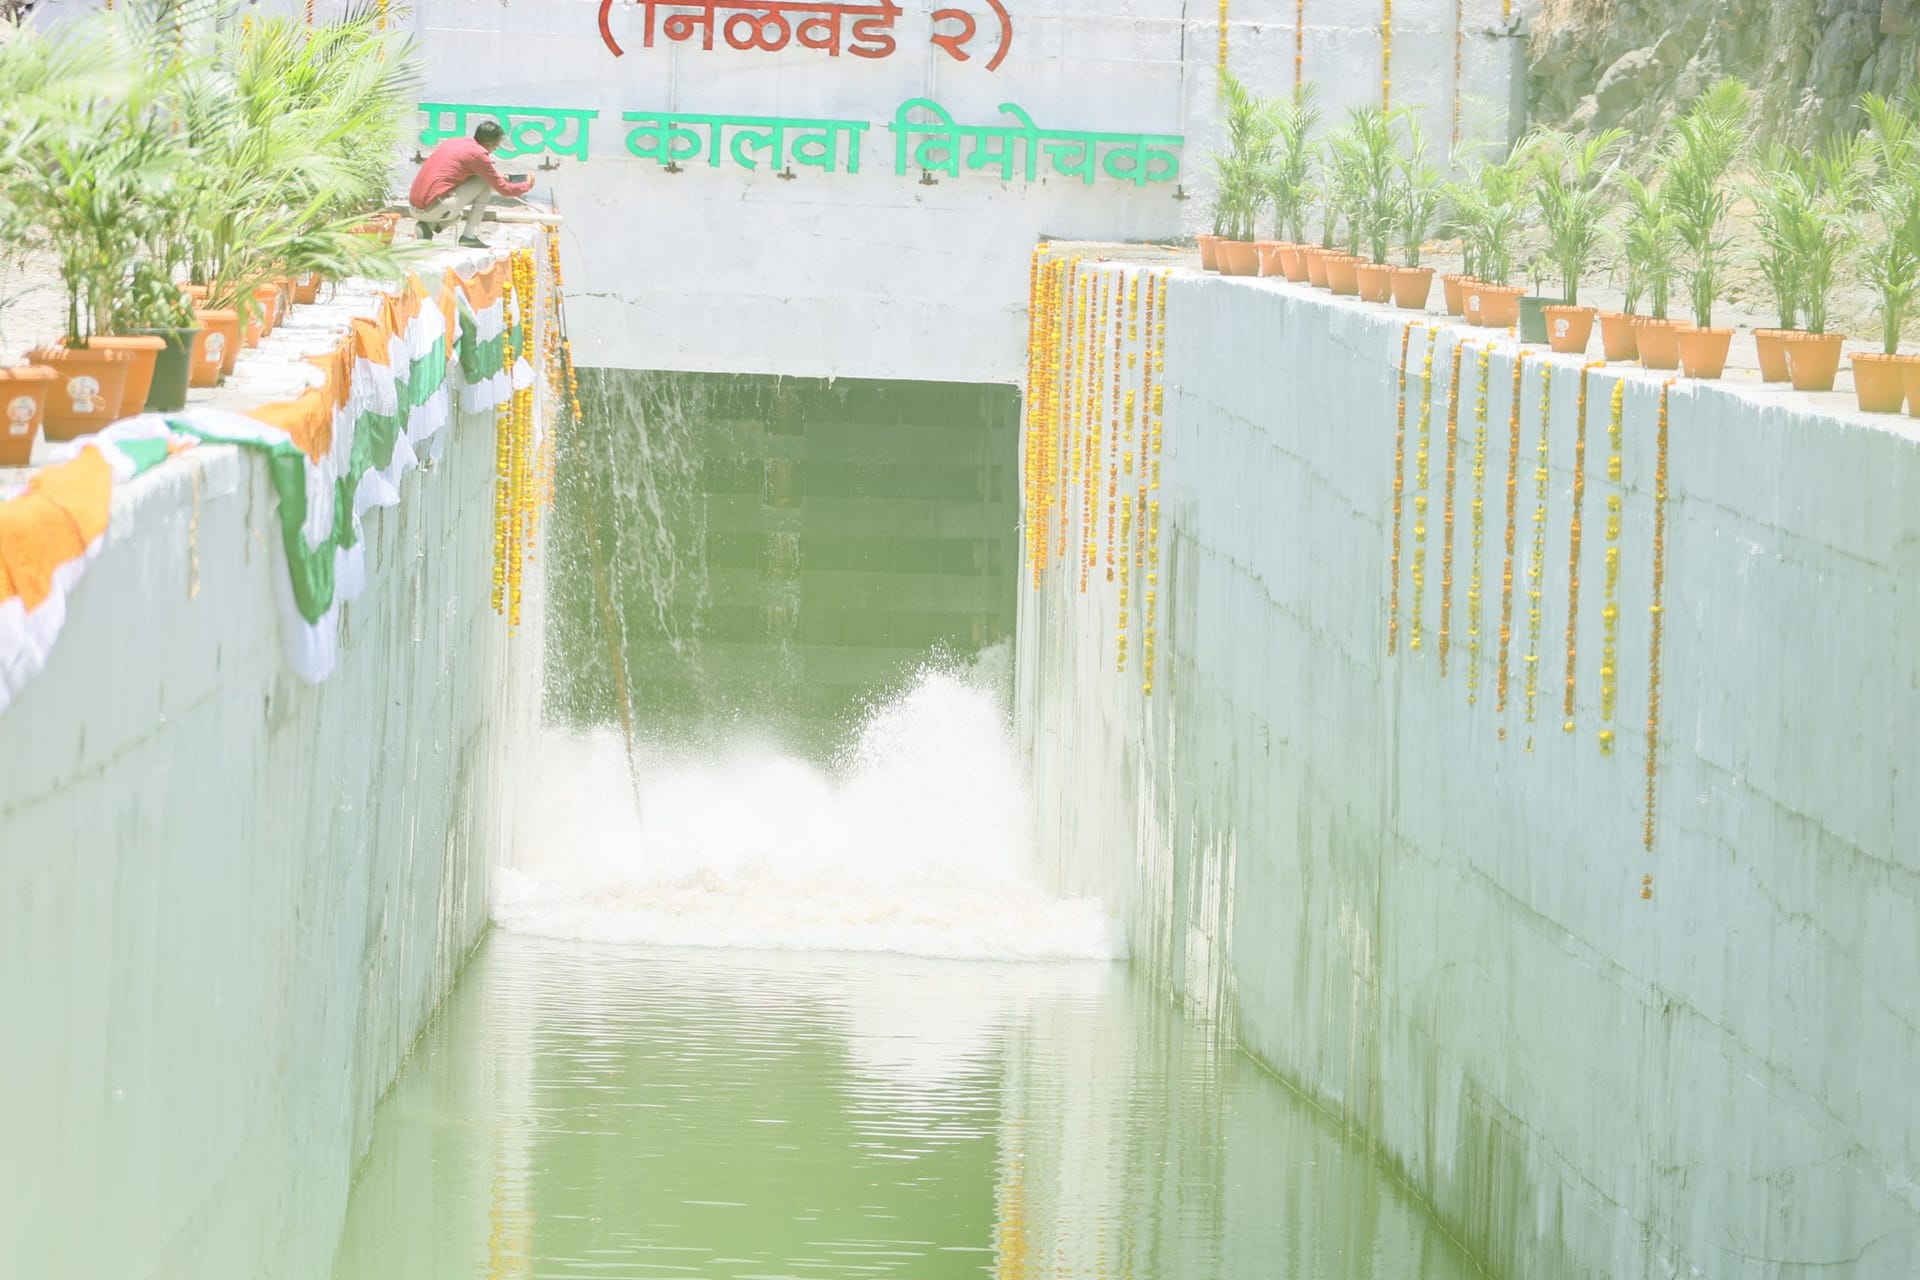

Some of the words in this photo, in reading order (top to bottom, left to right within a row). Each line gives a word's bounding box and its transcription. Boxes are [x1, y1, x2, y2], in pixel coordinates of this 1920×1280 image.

[418, 102, 599, 162] मख्य
[622, 111, 871, 174] कालवा
[888, 97, 1185, 187] विमोचक
